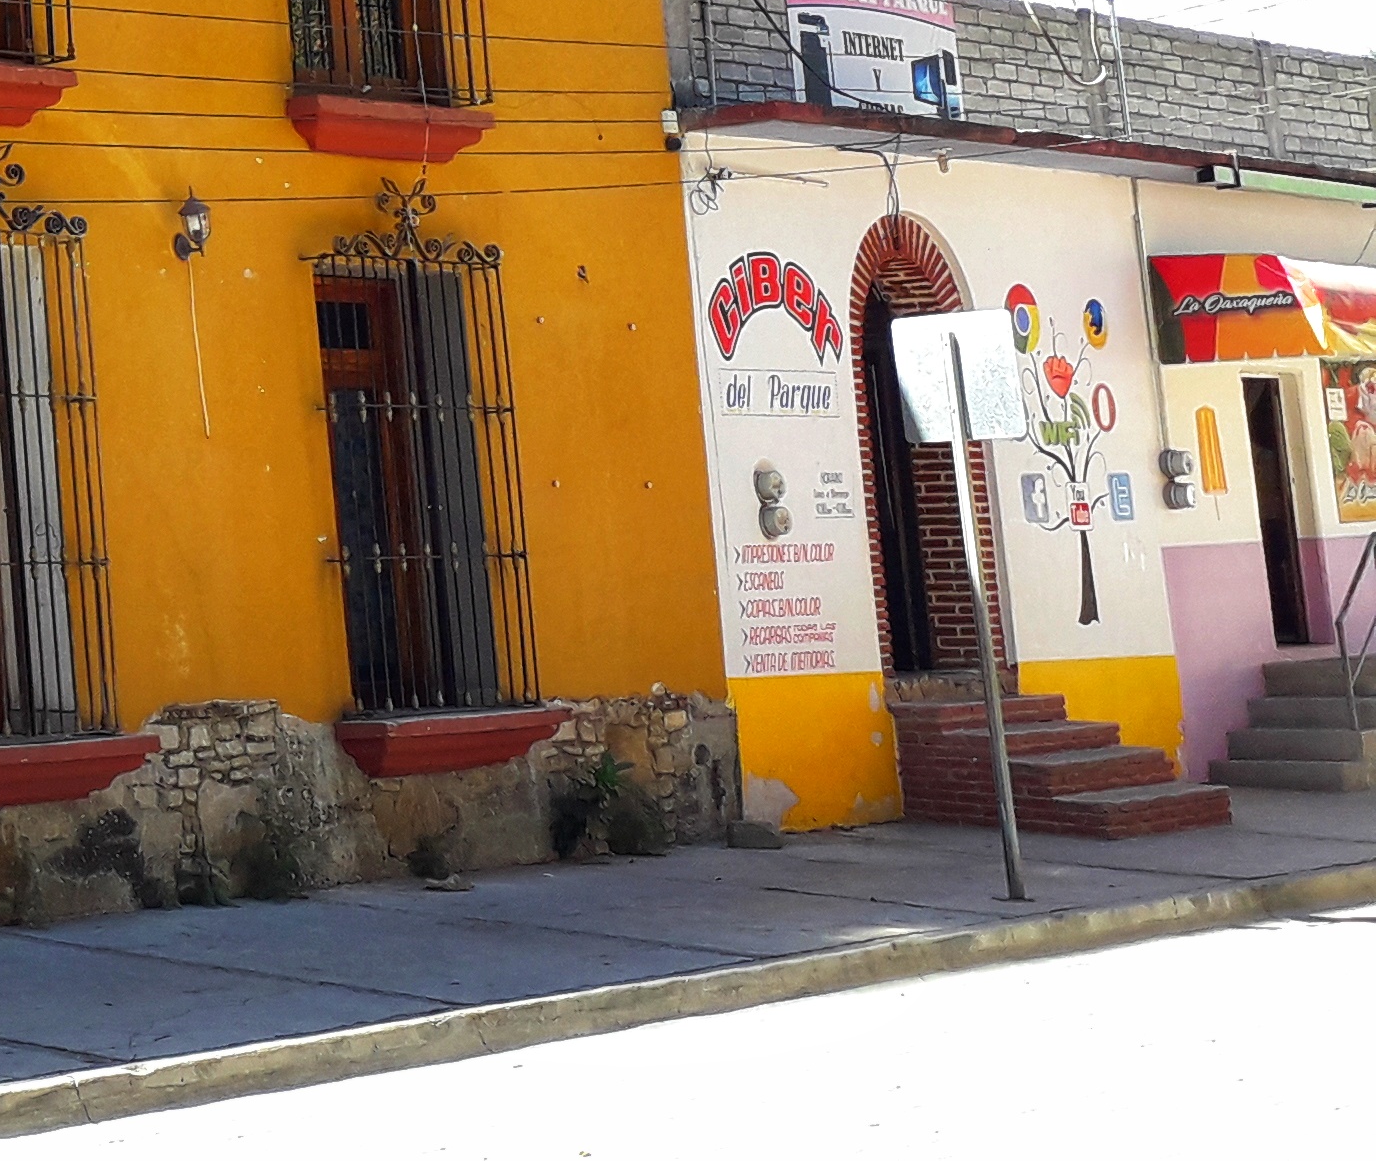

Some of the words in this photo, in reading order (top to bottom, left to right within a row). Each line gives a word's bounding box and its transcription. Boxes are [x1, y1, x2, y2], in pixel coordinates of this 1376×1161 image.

[842, 30, 904, 62] INTERNET
[873, 68, 881, 91] Y
[1174, 296, 1200, 315] La
[1204, 292, 1294, 314] Oaxaqueña
[726, 373, 752, 409] del
[767, 373, 832, 415] Parque
[743, 570, 785, 592] ESCANEOS
[777, 652, 789, 672] DE
